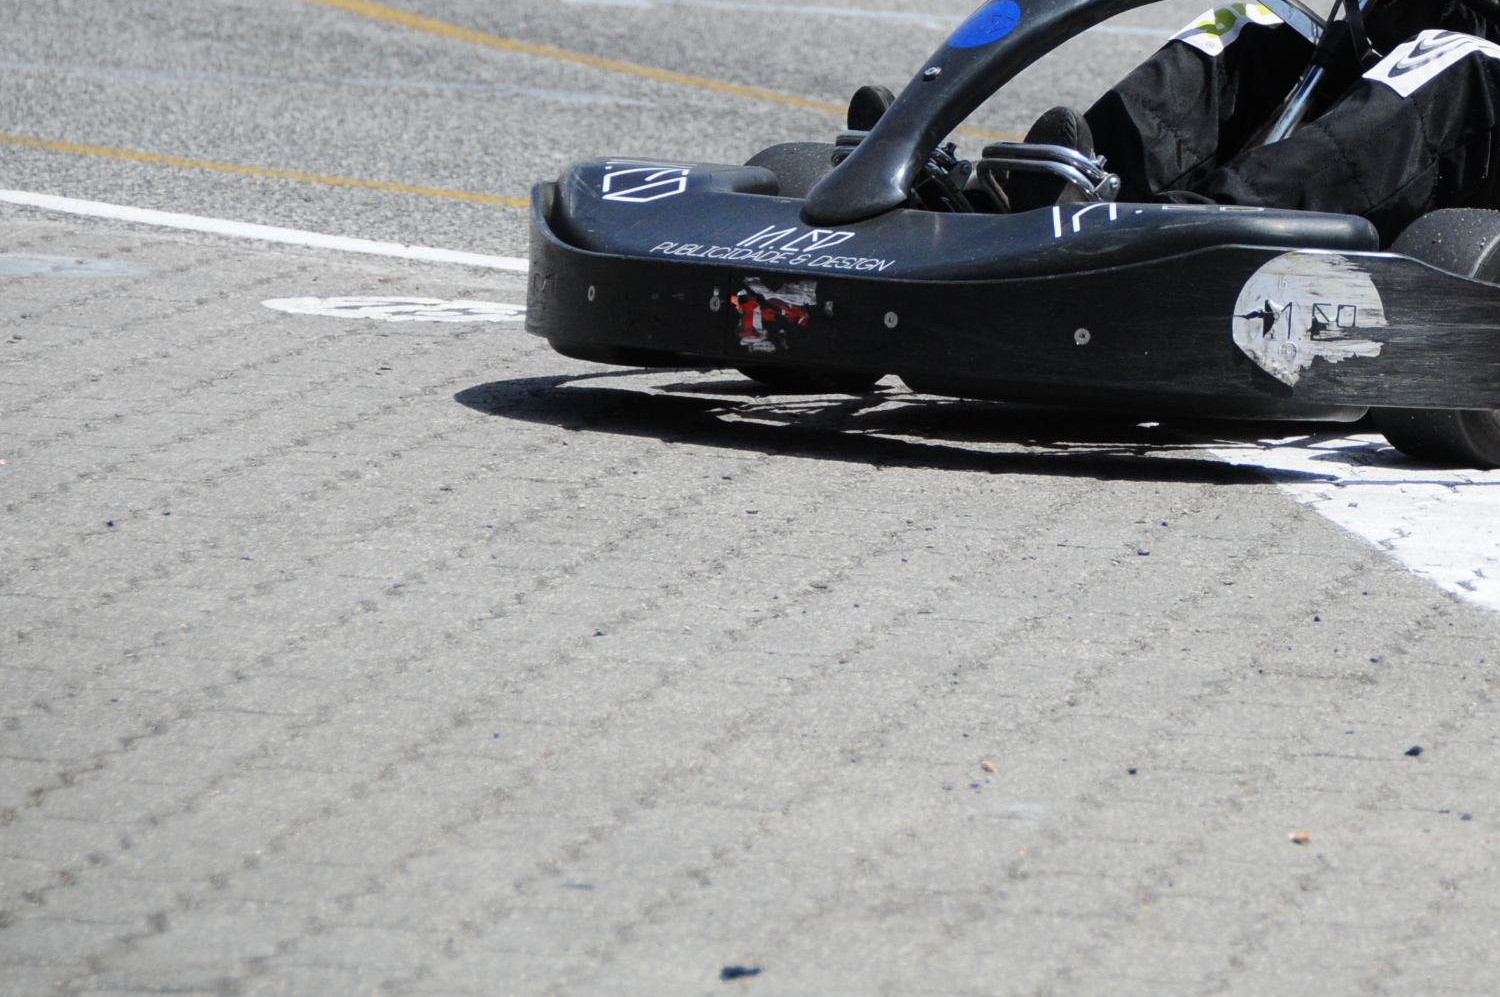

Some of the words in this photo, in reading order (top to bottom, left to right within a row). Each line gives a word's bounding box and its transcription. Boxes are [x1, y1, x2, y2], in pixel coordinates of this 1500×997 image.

[649, 240, 787, 265] PUBLICIDADE
[789, 253, 812, 266] &
[807, 254, 897, 273] DESIGN
